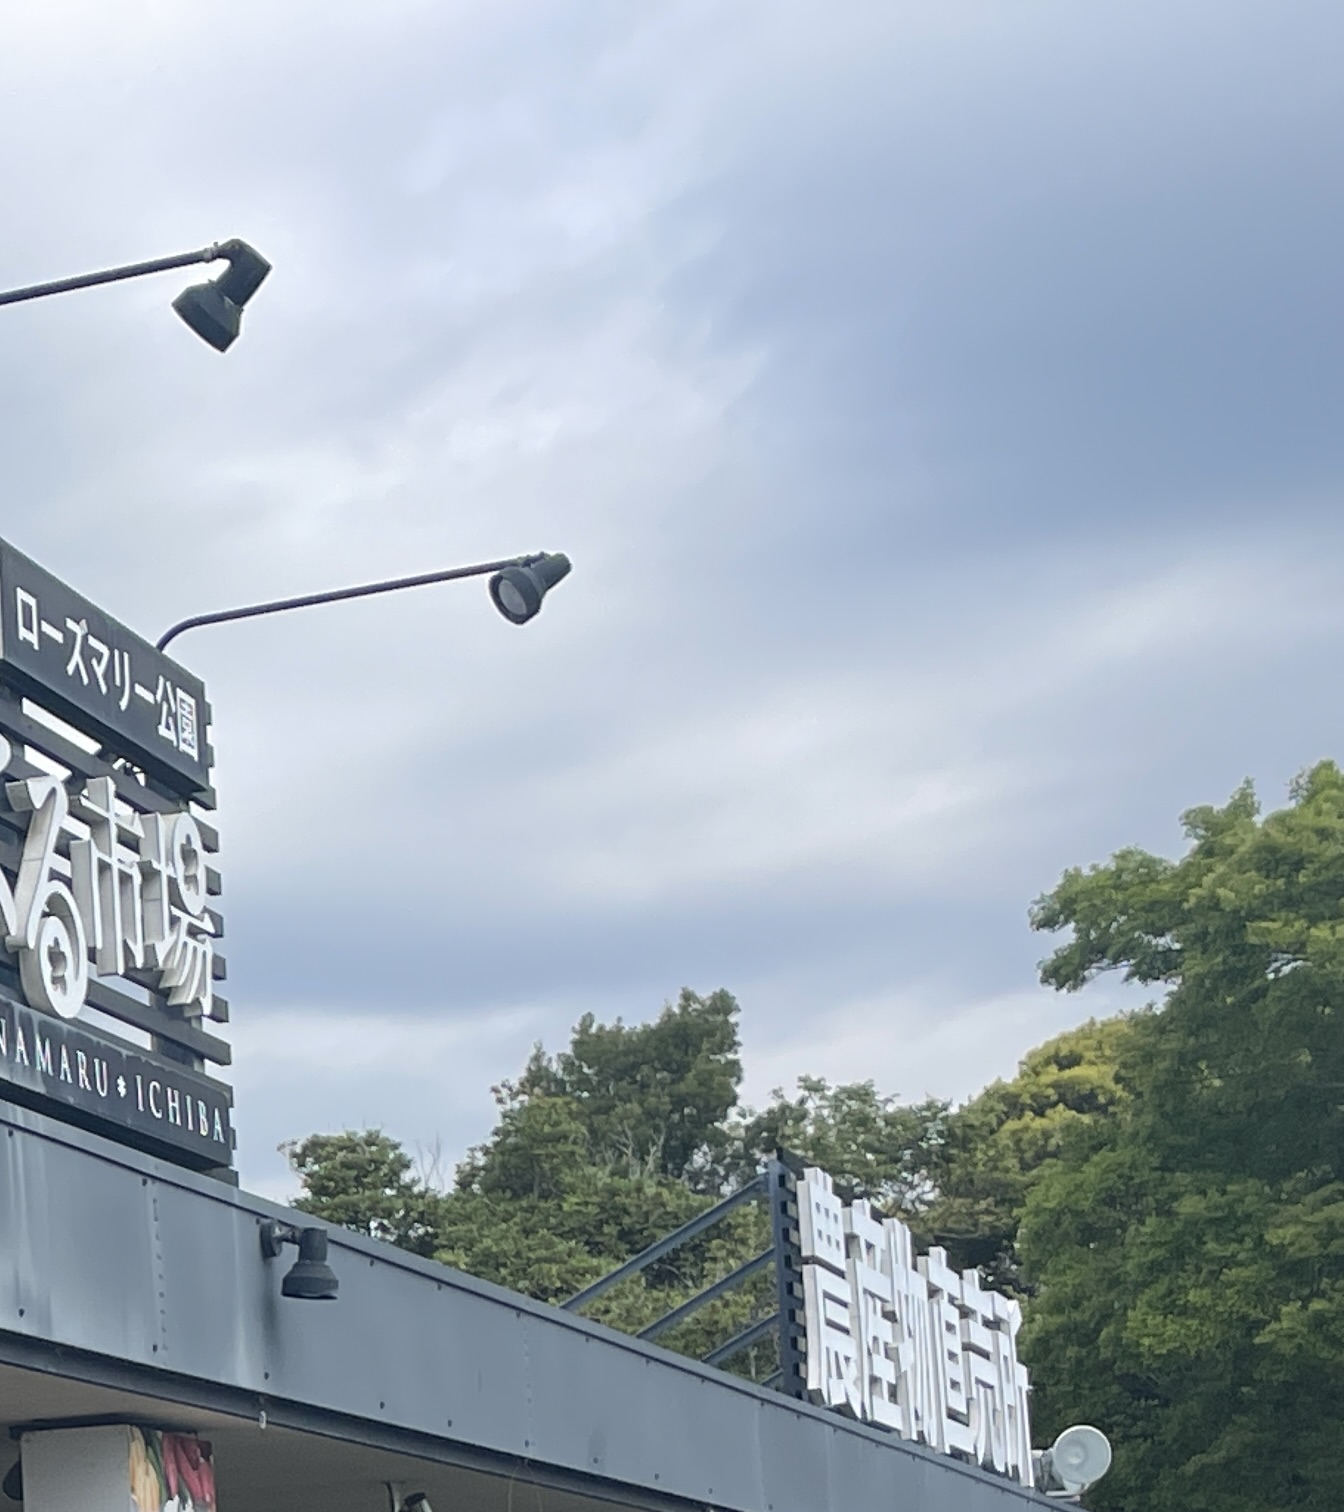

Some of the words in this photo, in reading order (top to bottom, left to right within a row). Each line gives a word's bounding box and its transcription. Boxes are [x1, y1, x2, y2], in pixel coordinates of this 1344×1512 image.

[15, 586, 199, 763] ローズマリー公園
[135, 1074, 226, 1144] ICHIBA
